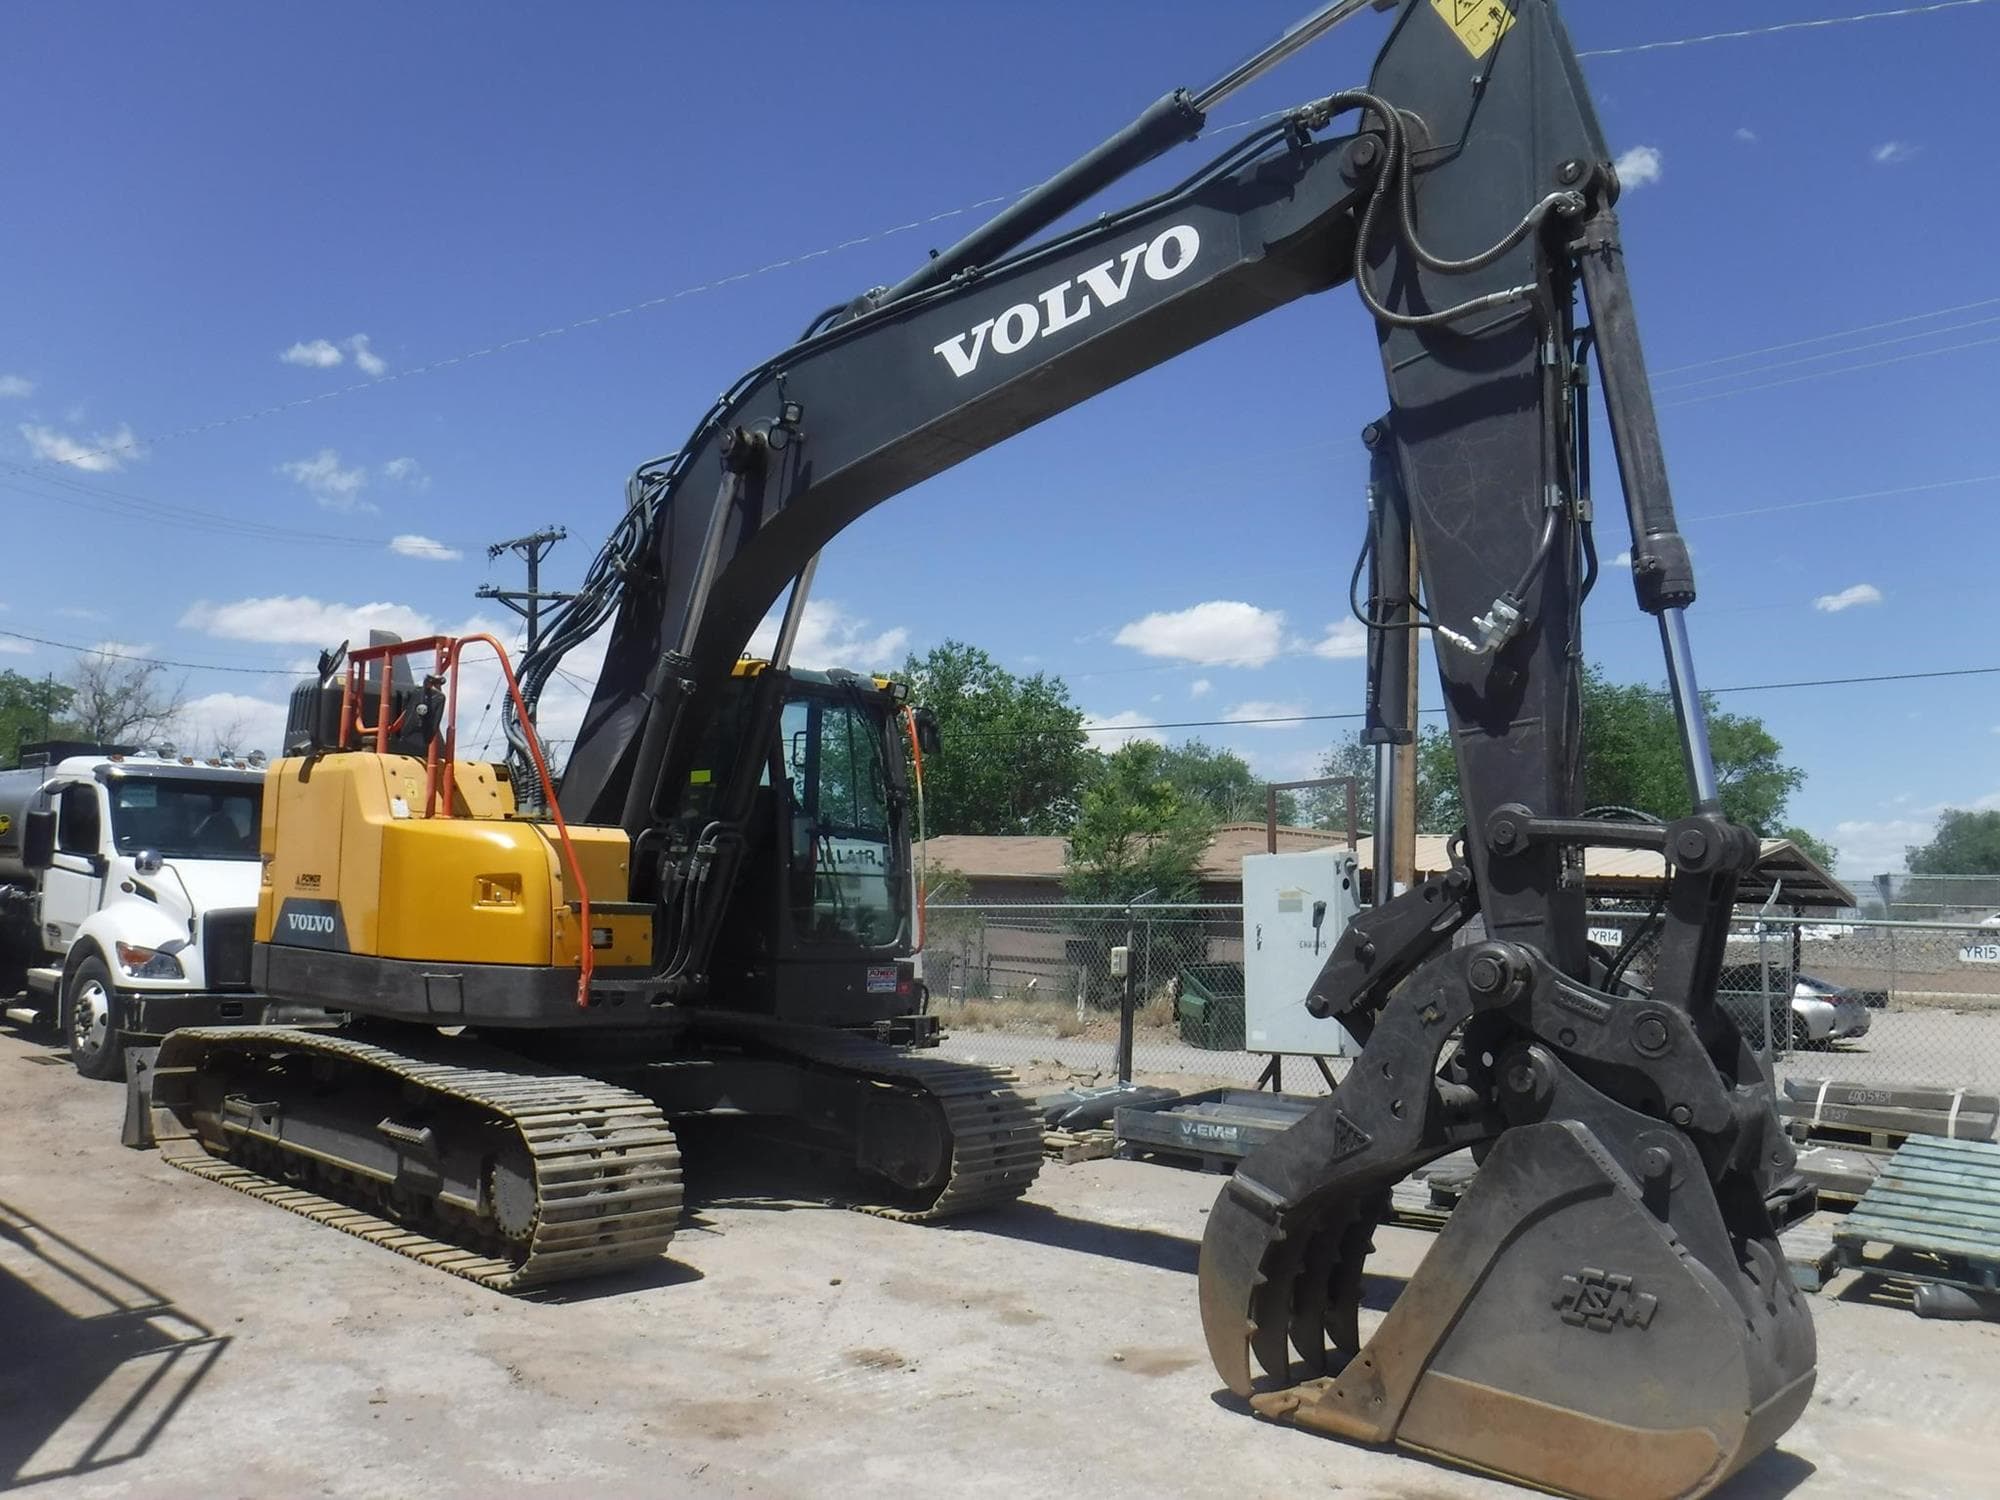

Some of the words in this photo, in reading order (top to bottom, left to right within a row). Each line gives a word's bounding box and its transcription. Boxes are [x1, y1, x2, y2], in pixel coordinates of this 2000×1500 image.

[934, 225, 1200, 377] VOLVO
[288, 913, 334, 933] VOLVO
[1592, 930, 1618, 942] YR14
[1963, 946, 1997, 959] YR15
